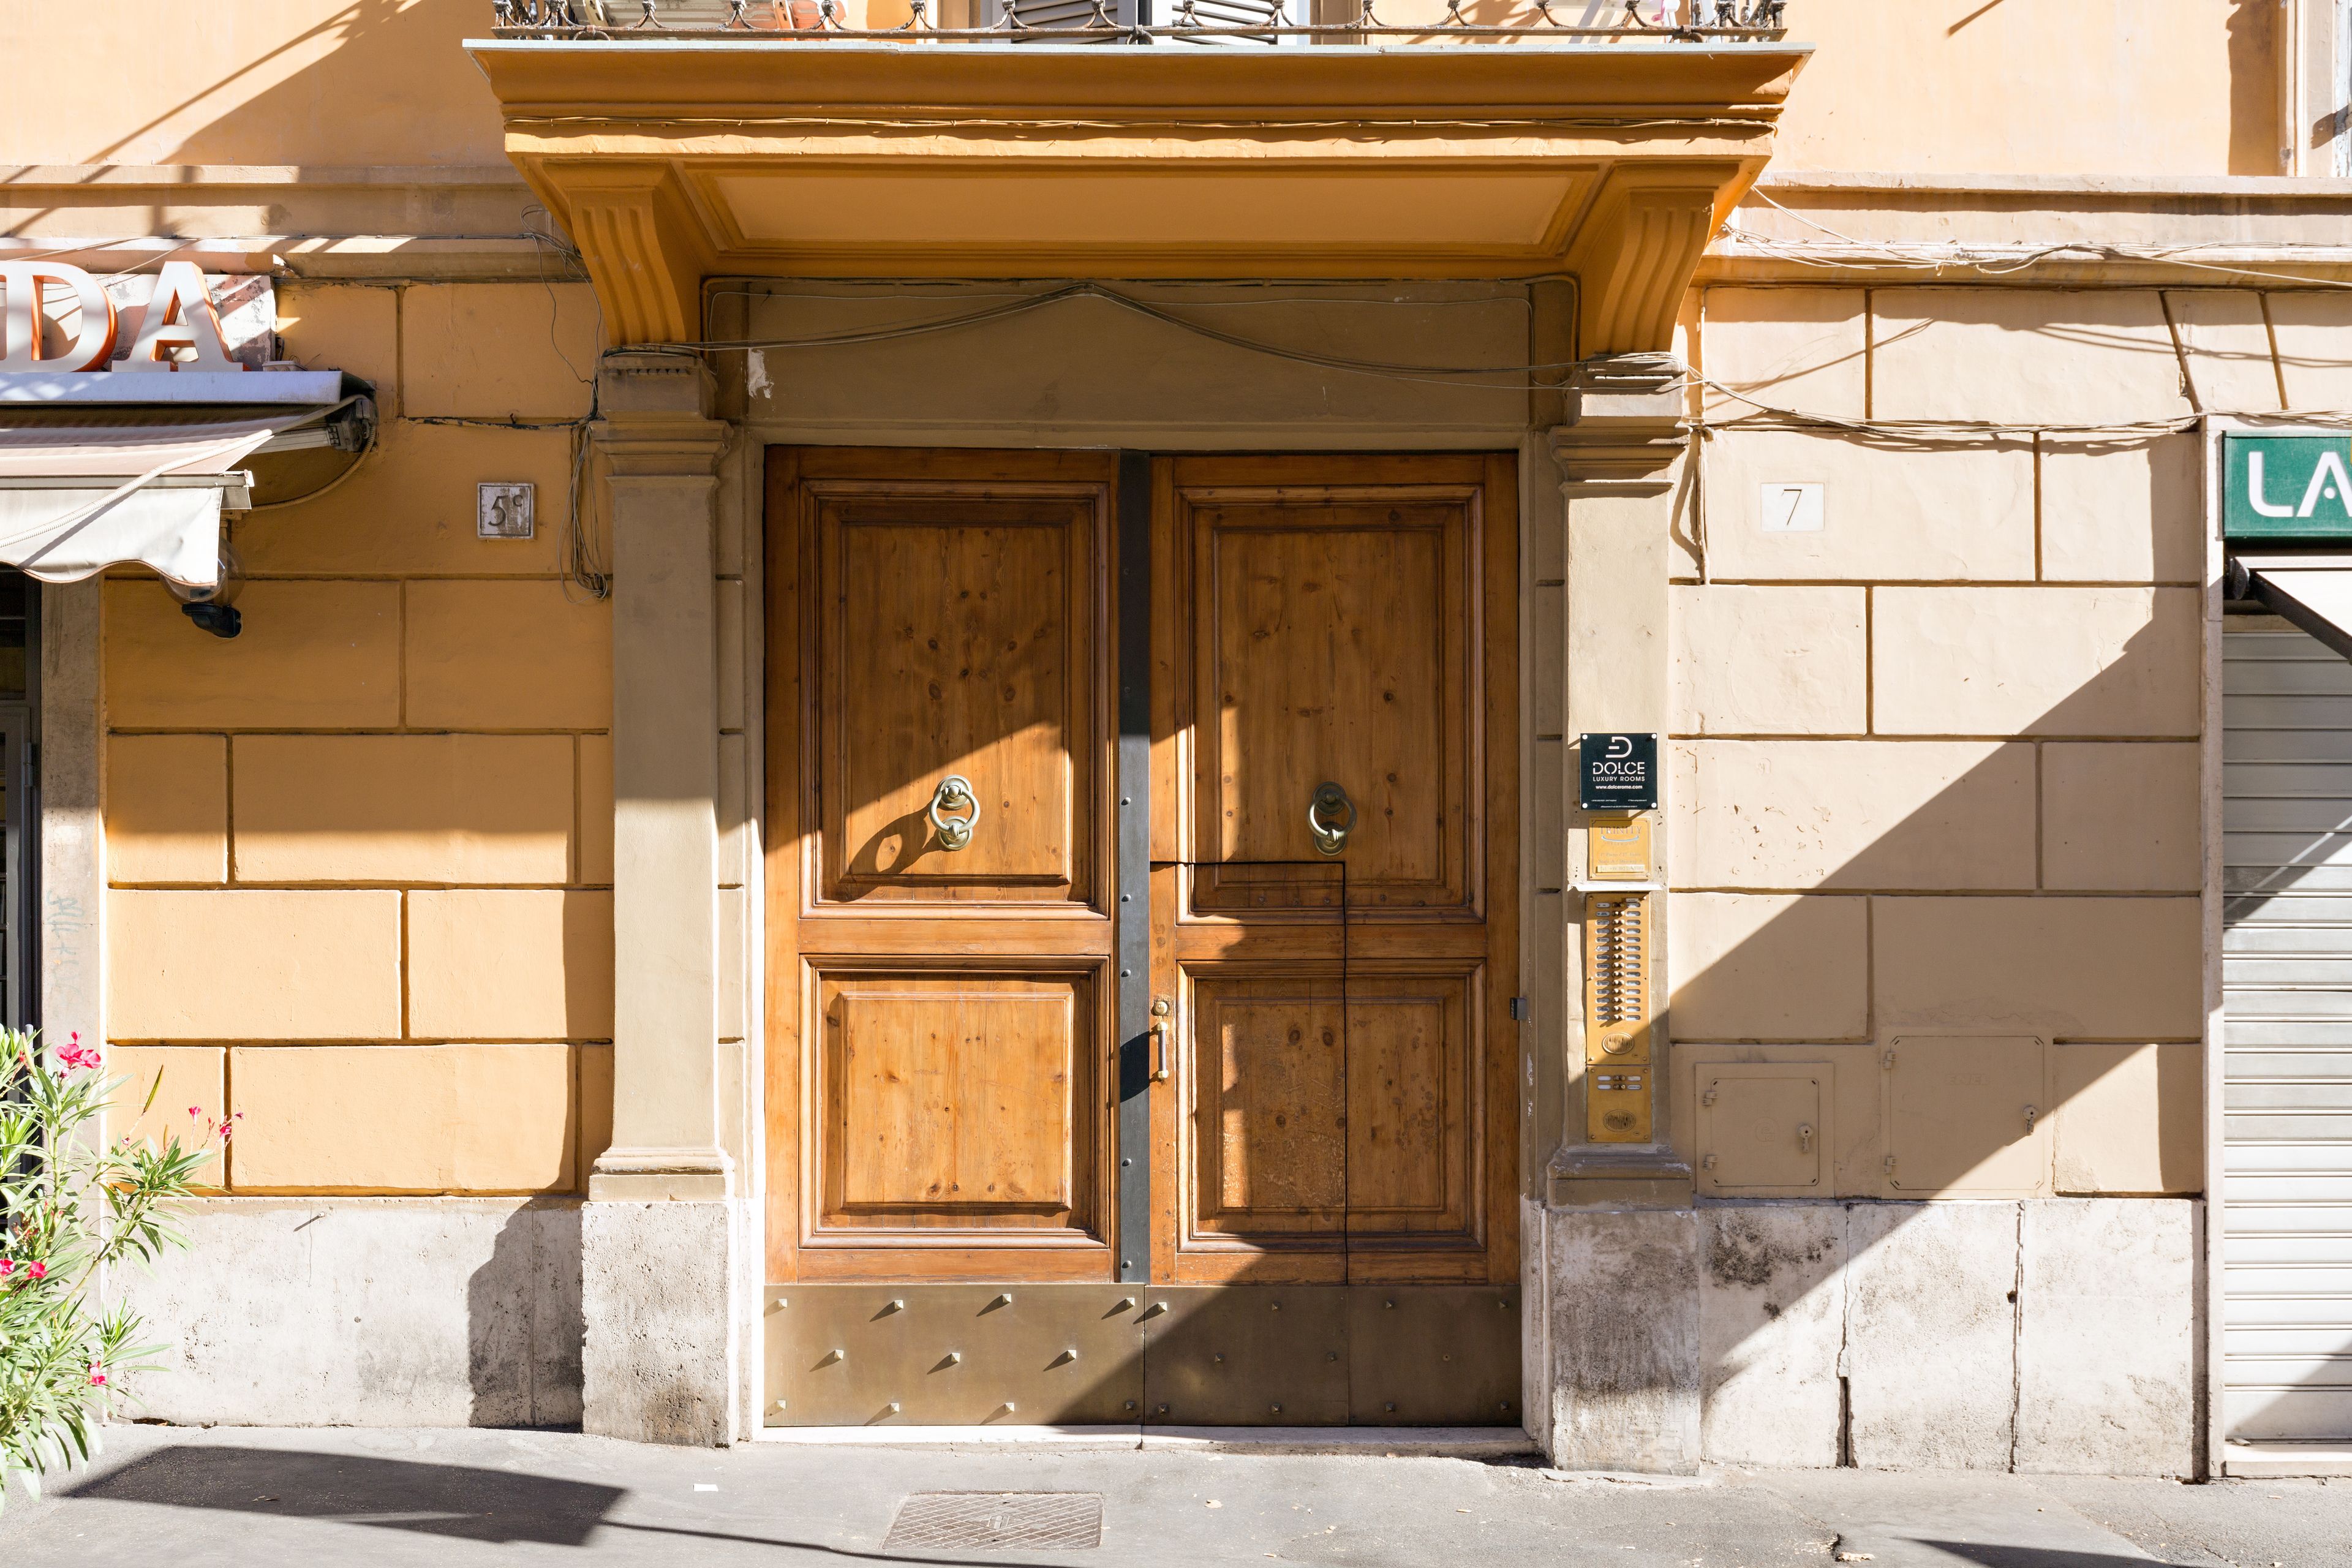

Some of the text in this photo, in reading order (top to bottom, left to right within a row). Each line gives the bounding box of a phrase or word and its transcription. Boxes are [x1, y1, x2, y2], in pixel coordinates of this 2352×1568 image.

[2248, 451, 2352, 518] LA
[1781, 489, 1803, 526] 7
[1593, 761, 1645, 775] DOLCE
[1599, 826, 1642, 834] TRINITY
